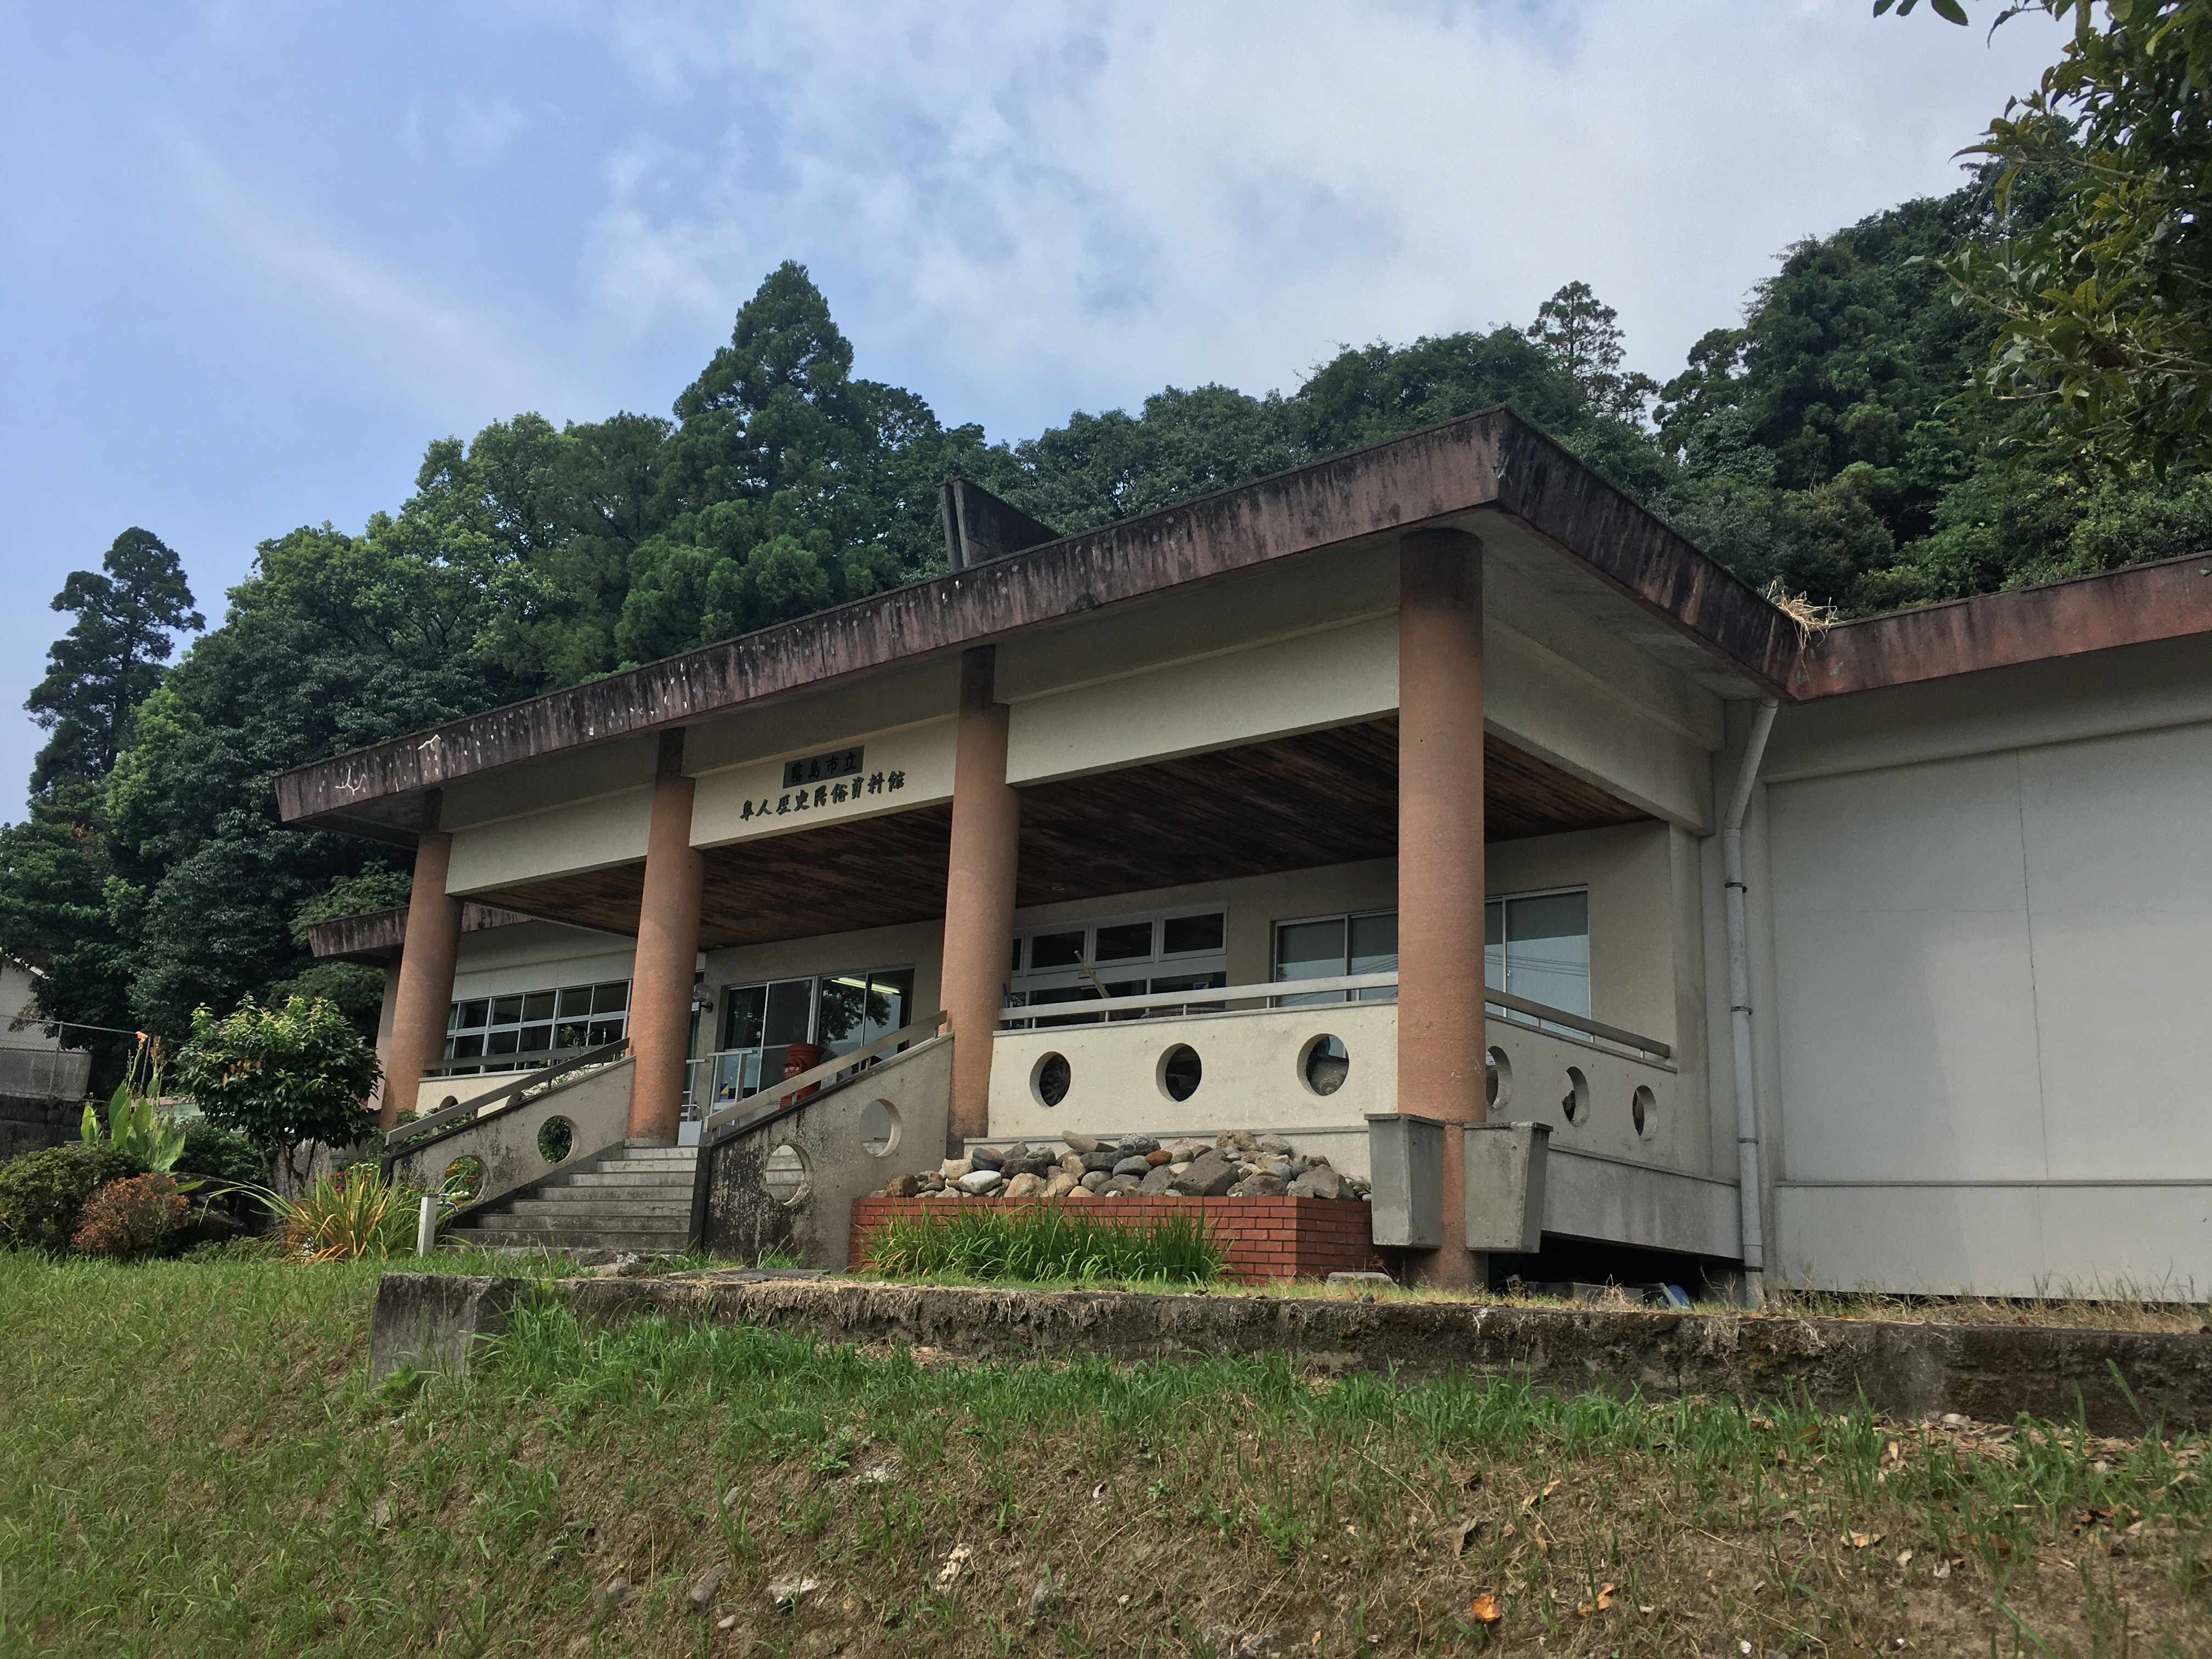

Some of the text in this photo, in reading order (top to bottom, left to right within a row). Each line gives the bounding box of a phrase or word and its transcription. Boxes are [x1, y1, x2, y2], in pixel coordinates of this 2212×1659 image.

[791, 751, 857, 782] 霧島市立
[740, 771, 906, 821] 隼人歴史民俗資料館
